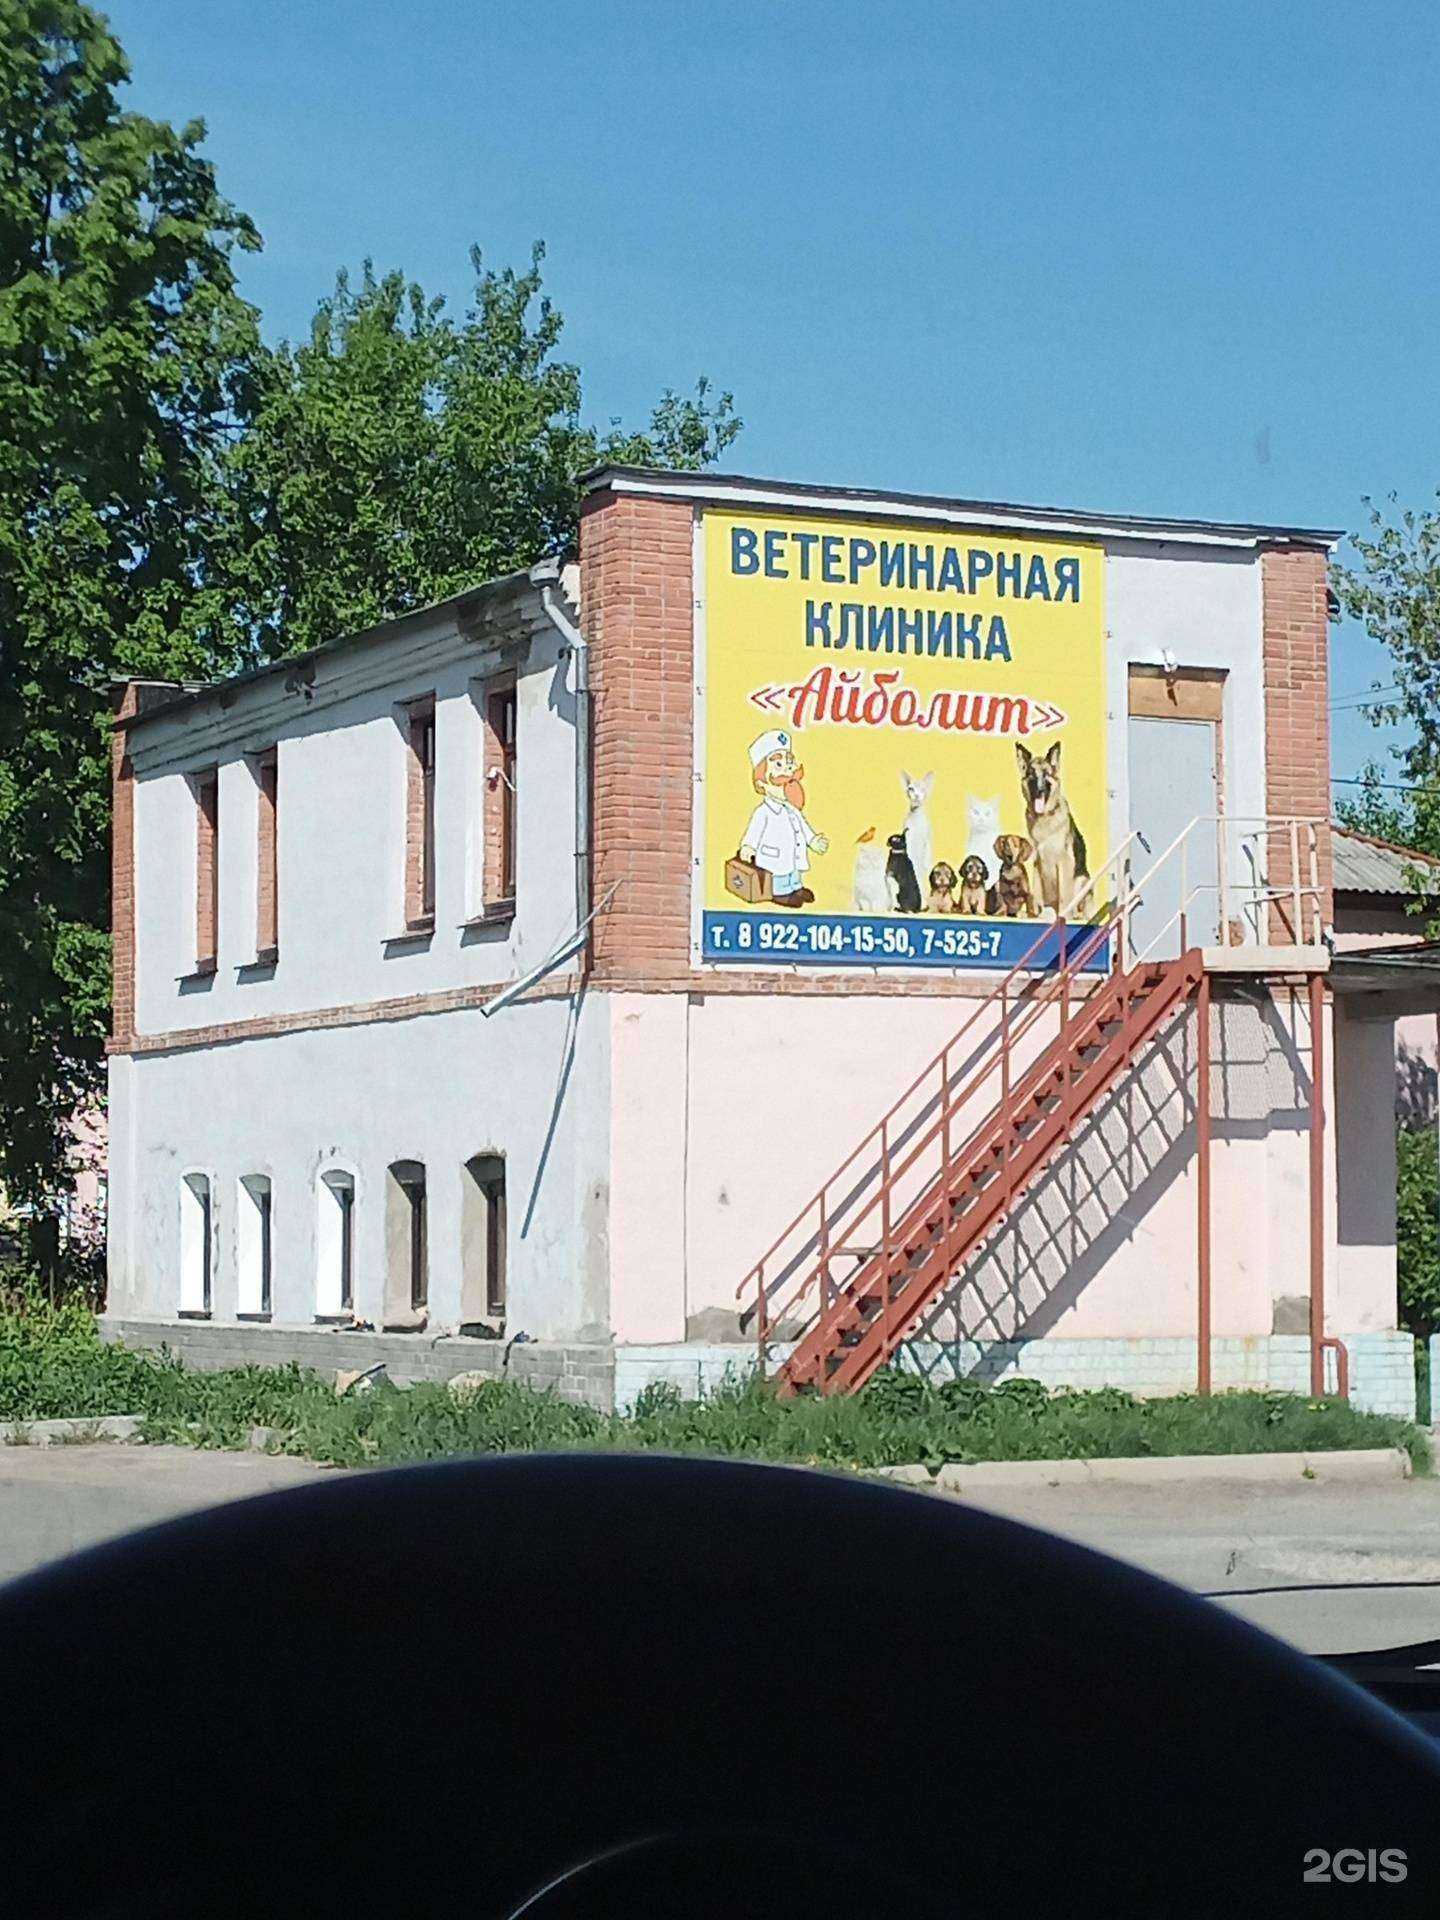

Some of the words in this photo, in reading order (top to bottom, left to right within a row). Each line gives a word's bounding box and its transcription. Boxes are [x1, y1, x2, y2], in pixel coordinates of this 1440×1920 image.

[731, 527, 1080, 603] ВЕТЕРИНАРНАЯ
[805, 600, 1012, 662] КЛИНИКА
[738, 922, 752, 948] 8
[759, 923, 915, 957] 922-104-15-50,
[923, 929, 1002, 957] 7-525-7
